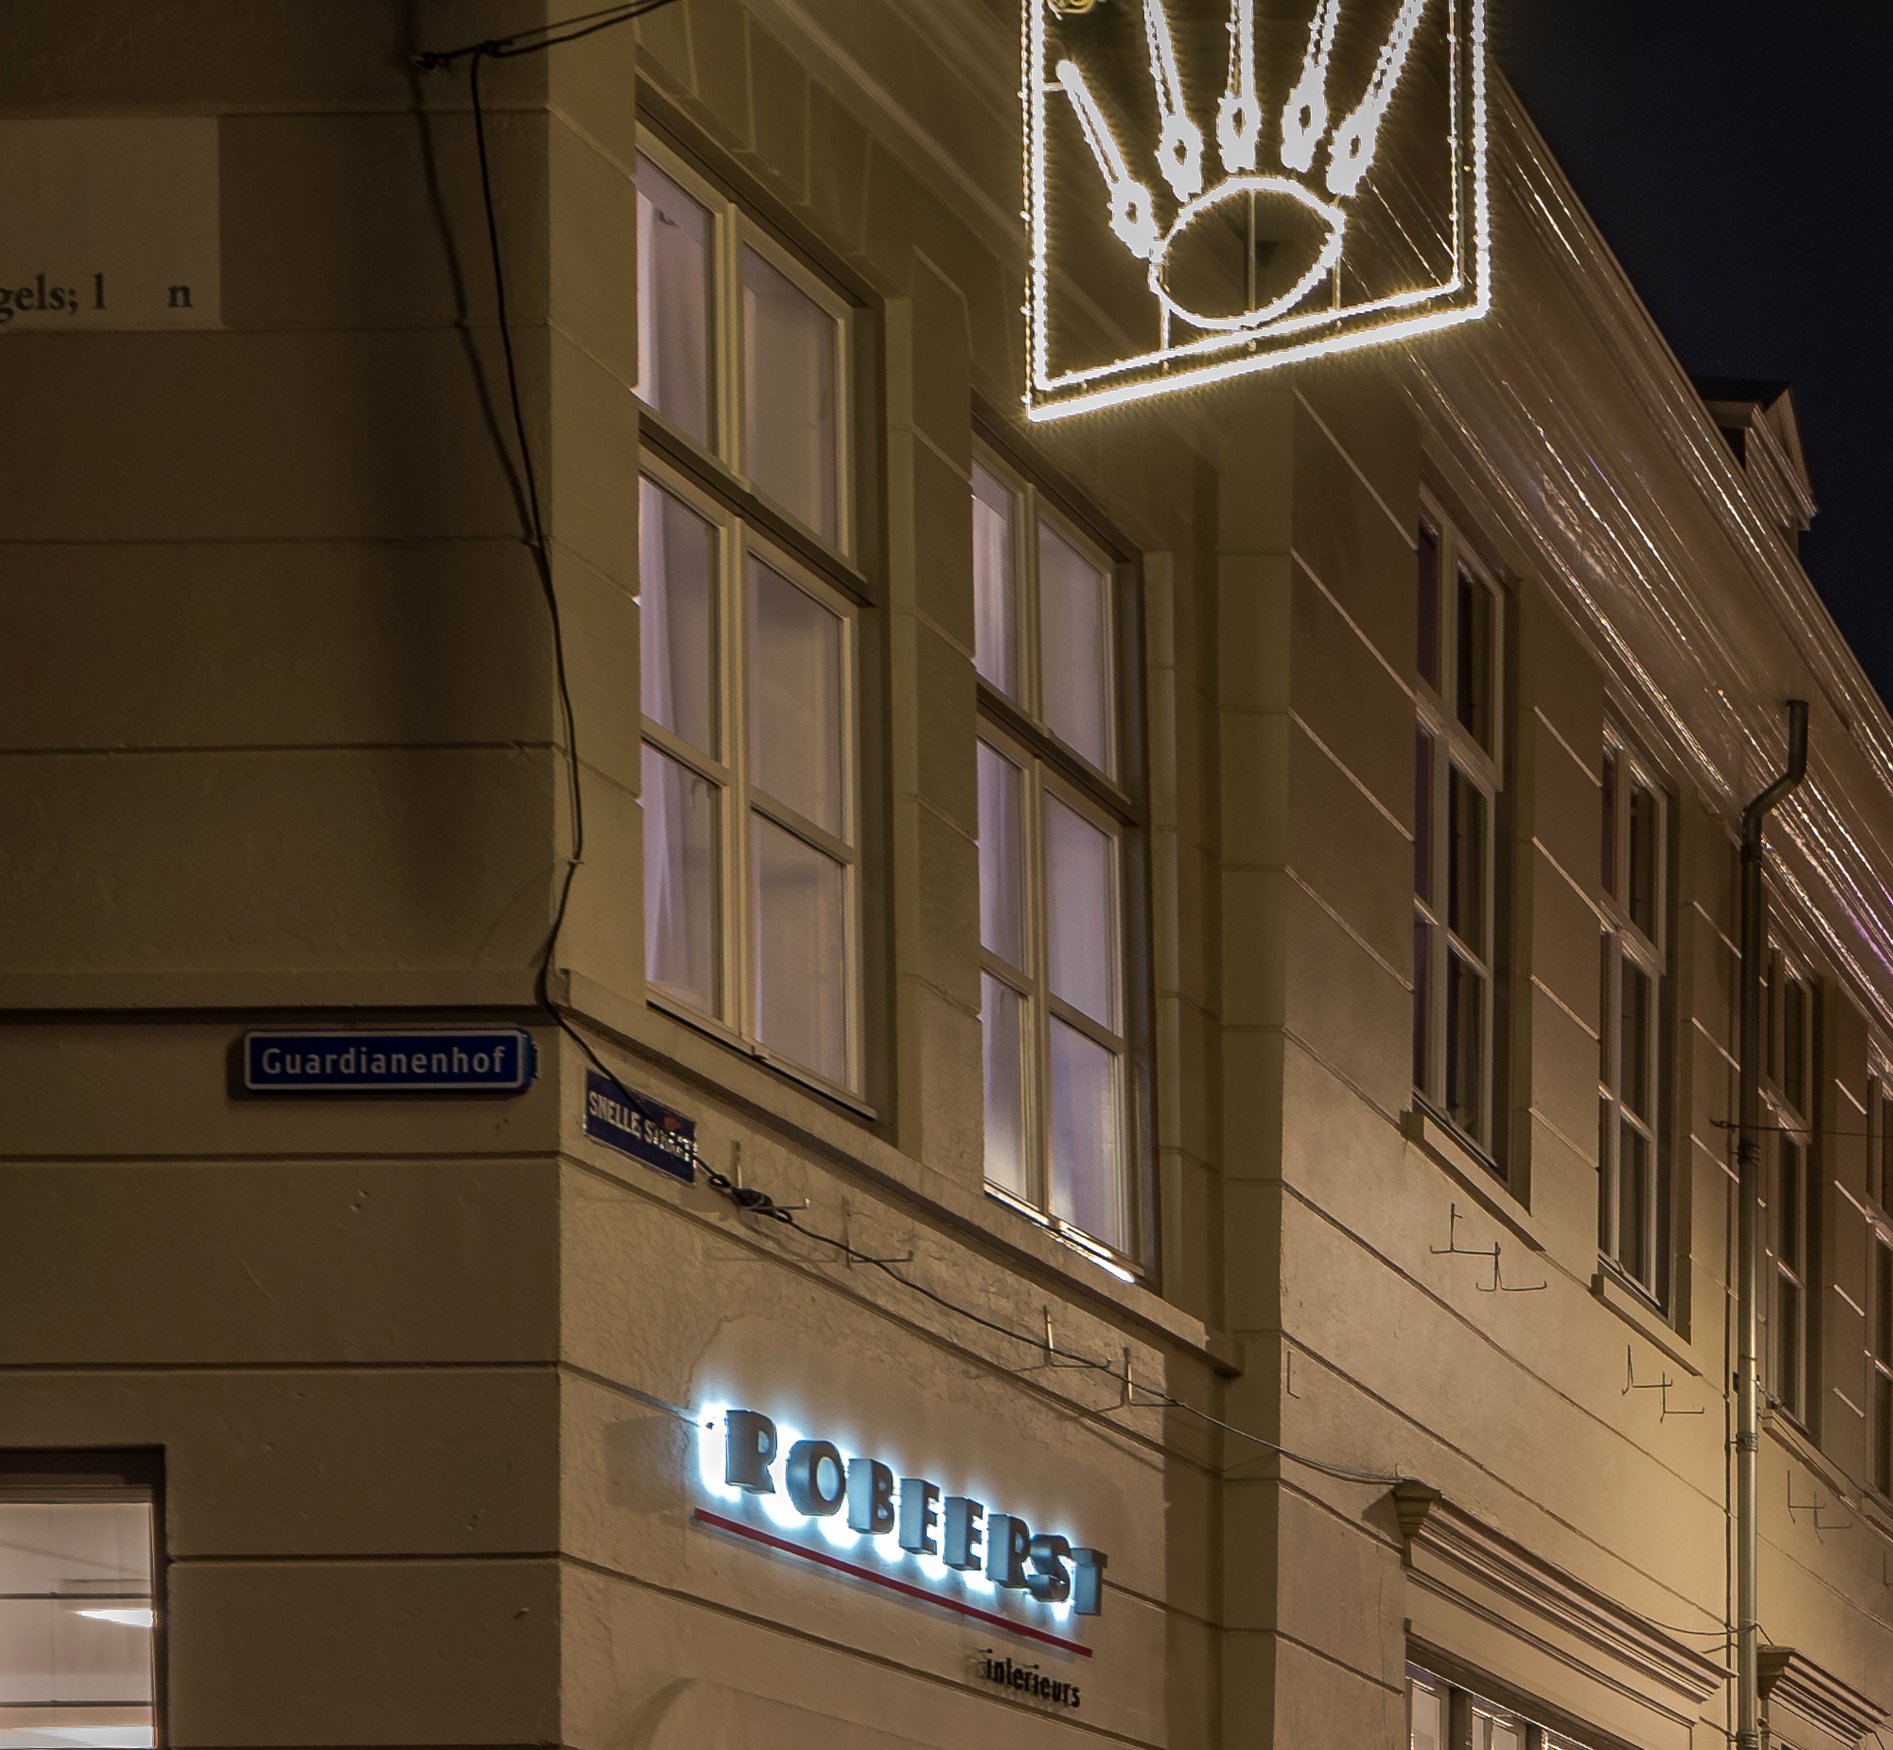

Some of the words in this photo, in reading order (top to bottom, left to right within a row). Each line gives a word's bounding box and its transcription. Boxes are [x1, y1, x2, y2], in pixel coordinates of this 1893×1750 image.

[261, 1046, 506, 1075] Guardianenhof
[589, 1090, 641, 1139] SNELLE
[725, 1408, 1108, 1616] ROBEERST
[985, 1647, 1081, 1708] interieurs
